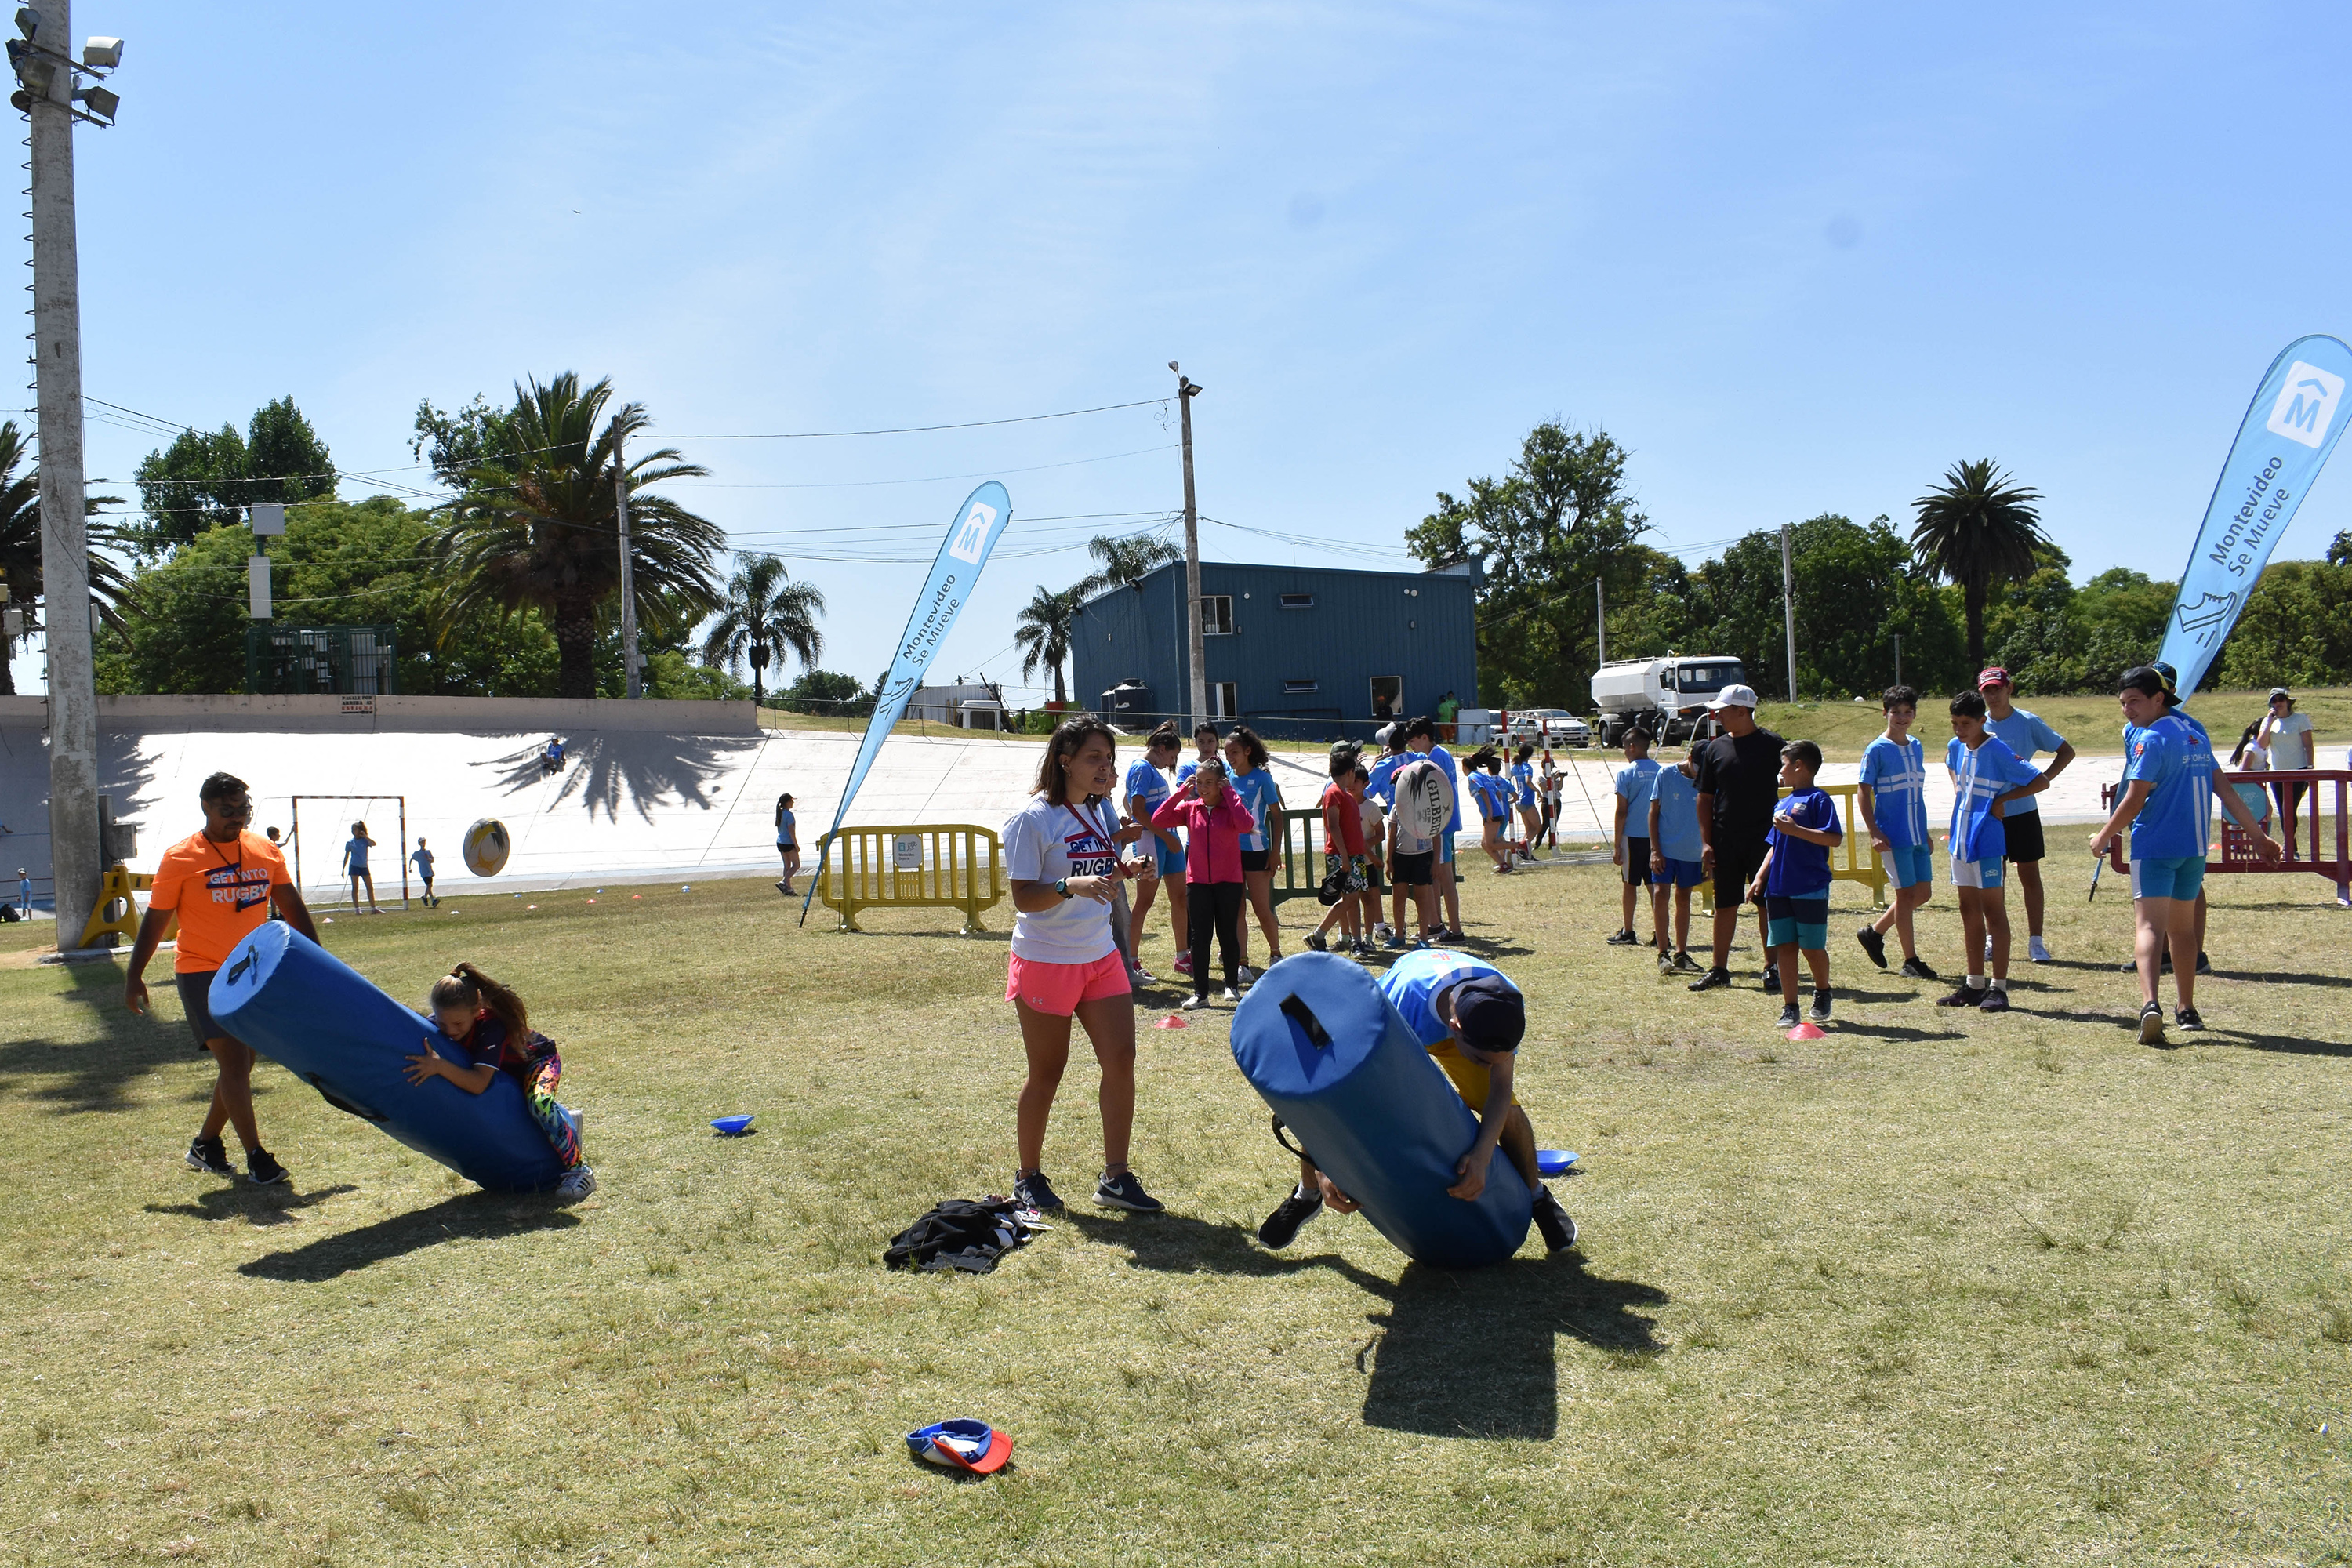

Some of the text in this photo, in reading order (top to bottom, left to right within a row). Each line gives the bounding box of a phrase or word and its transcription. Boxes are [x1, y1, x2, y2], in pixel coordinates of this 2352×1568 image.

[2283, 393, 2321, 433] M
[2209, 456, 2282, 565] Montevideo
[958, 524, 980, 554] M
[2228, 488, 2290, 577] Se Mueve
[902, 574, 956, 659] Montevideo
[912, 598, 960, 667] Se Mueve
[1070, 839, 1109, 852] GET IN
[210, 868, 267, 884] GET NTO
[1071, 858, 1115, 877] RUGB
[212, 884, 270, 903] RUGBY
